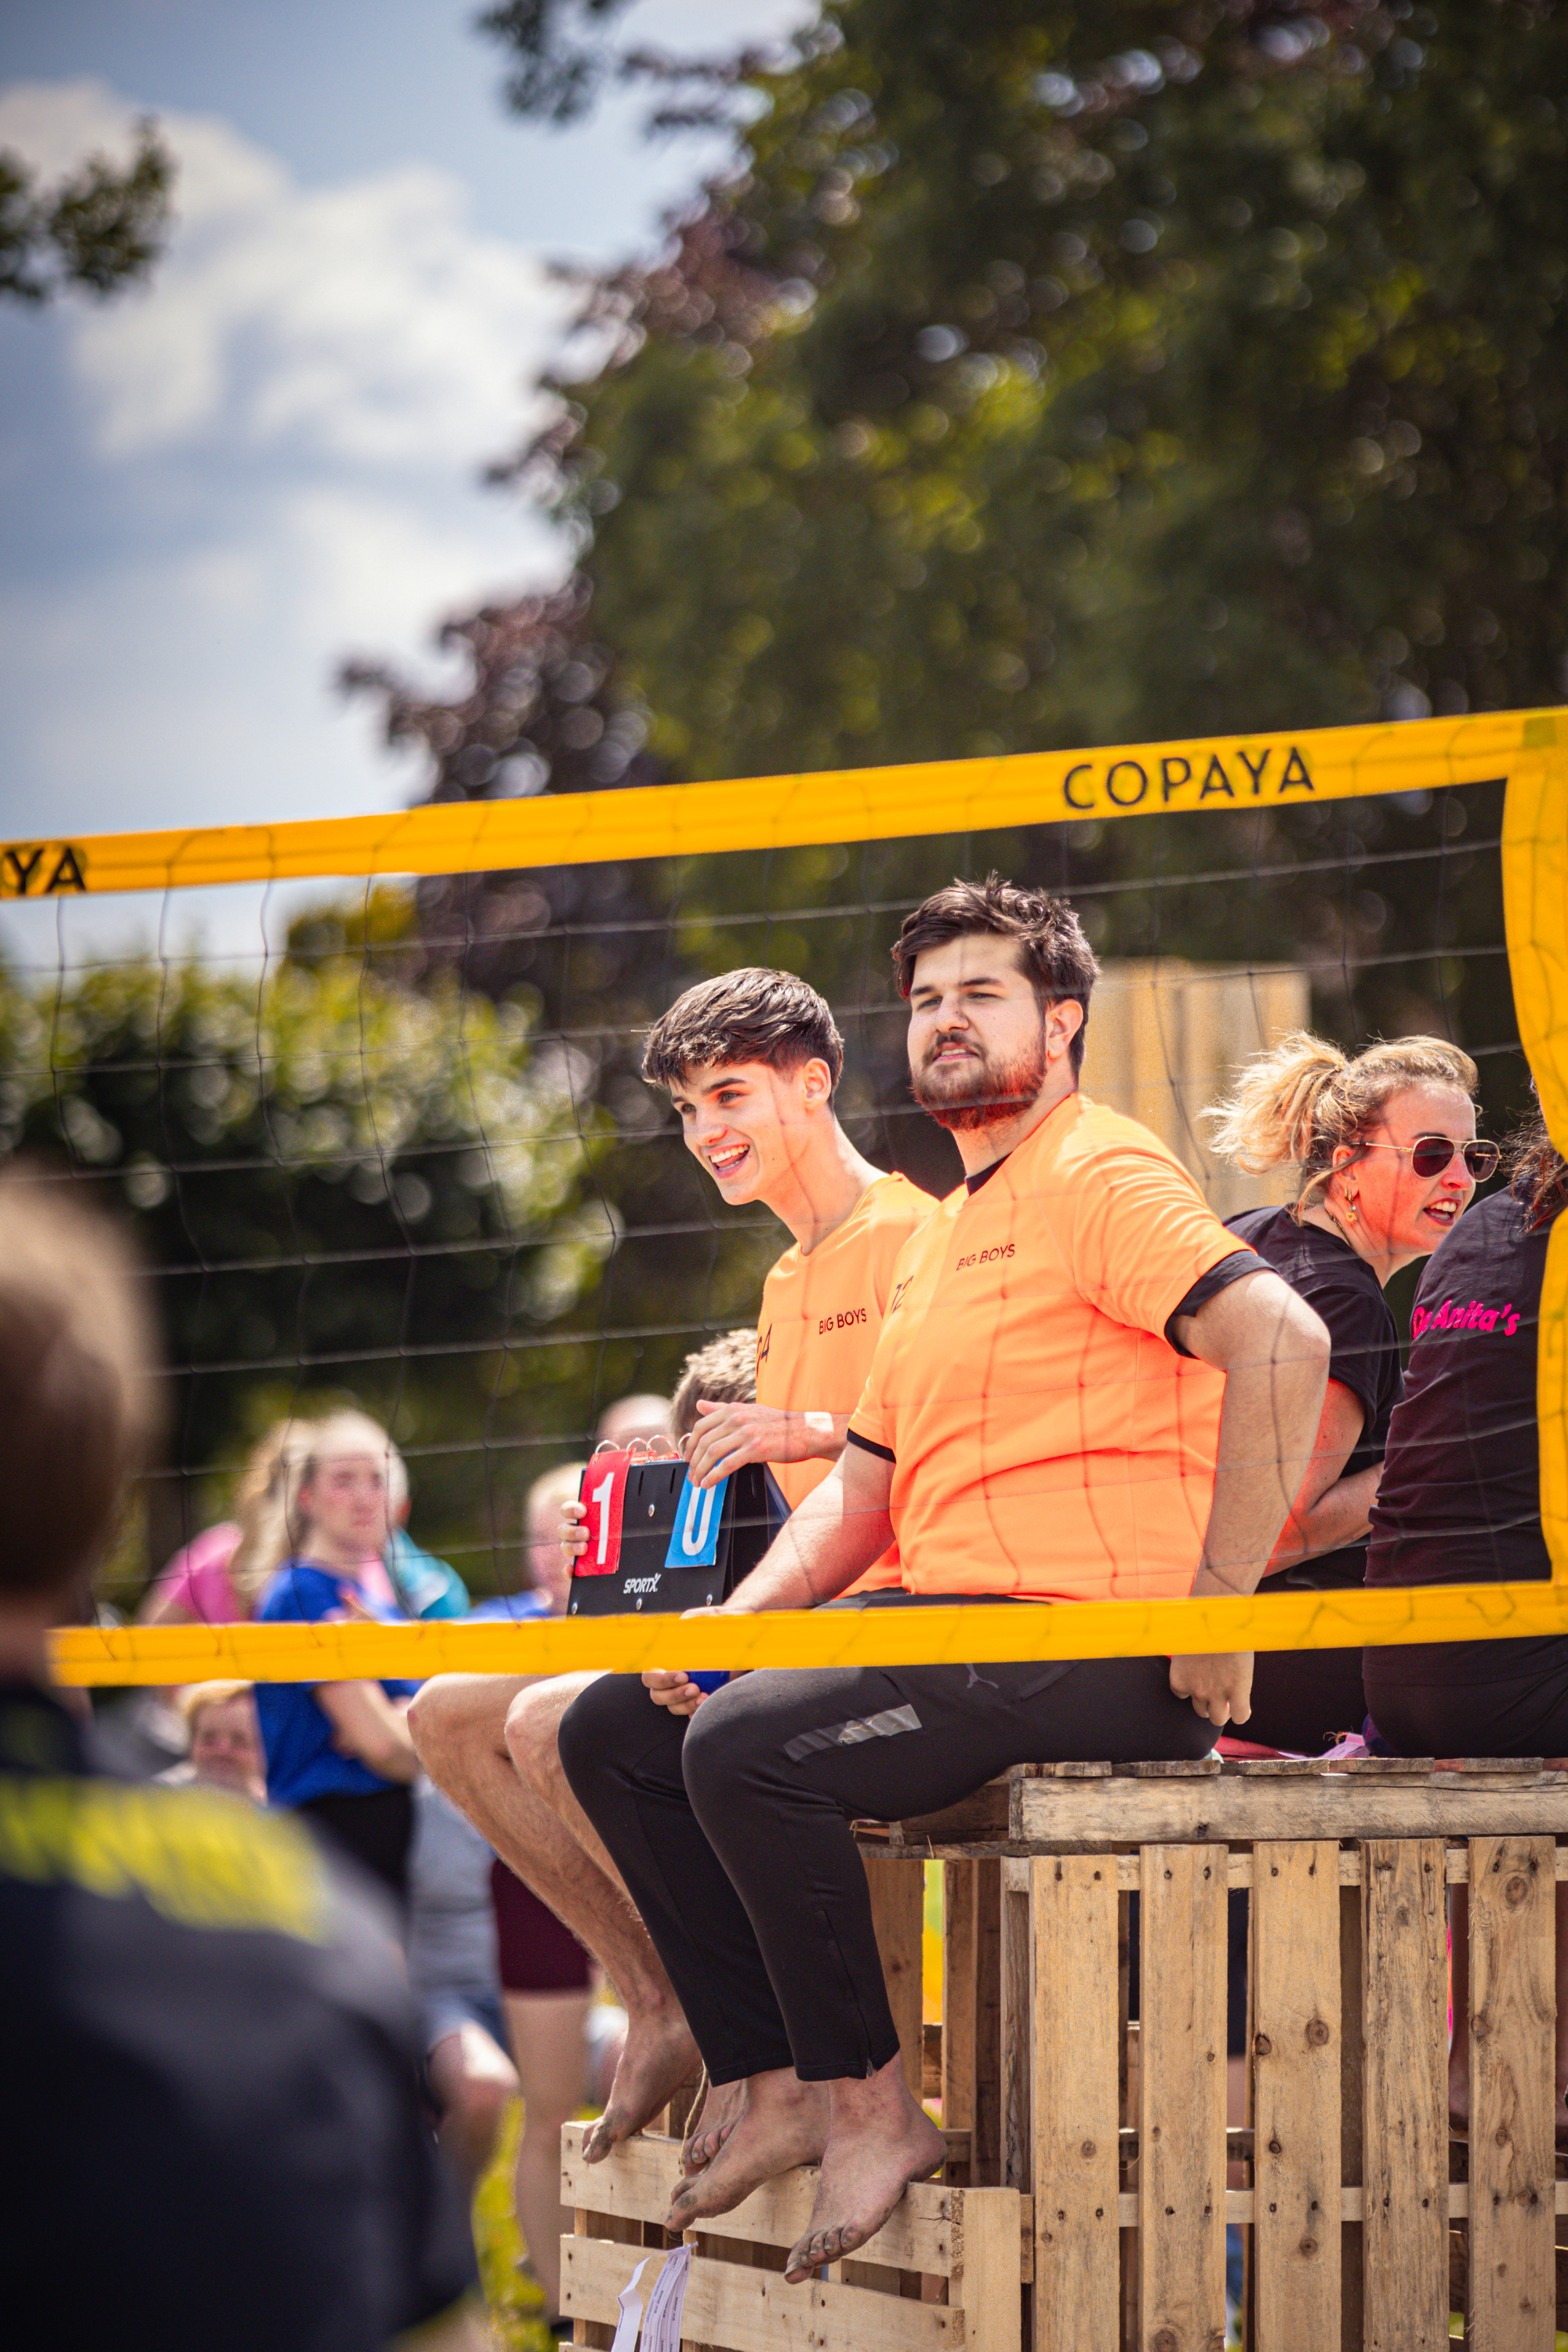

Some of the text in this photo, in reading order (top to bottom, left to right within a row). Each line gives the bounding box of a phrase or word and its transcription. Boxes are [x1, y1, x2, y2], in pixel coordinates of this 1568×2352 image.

[1062, 746, 1315, 810] COPAYA
[5, 846, 86, 895] YA
[956, 1243, 1015, 1272] BIG BOYS
[819, 1308, 867, 1335] BIG BOYS
[592, 1472, 615, 1565] 1
